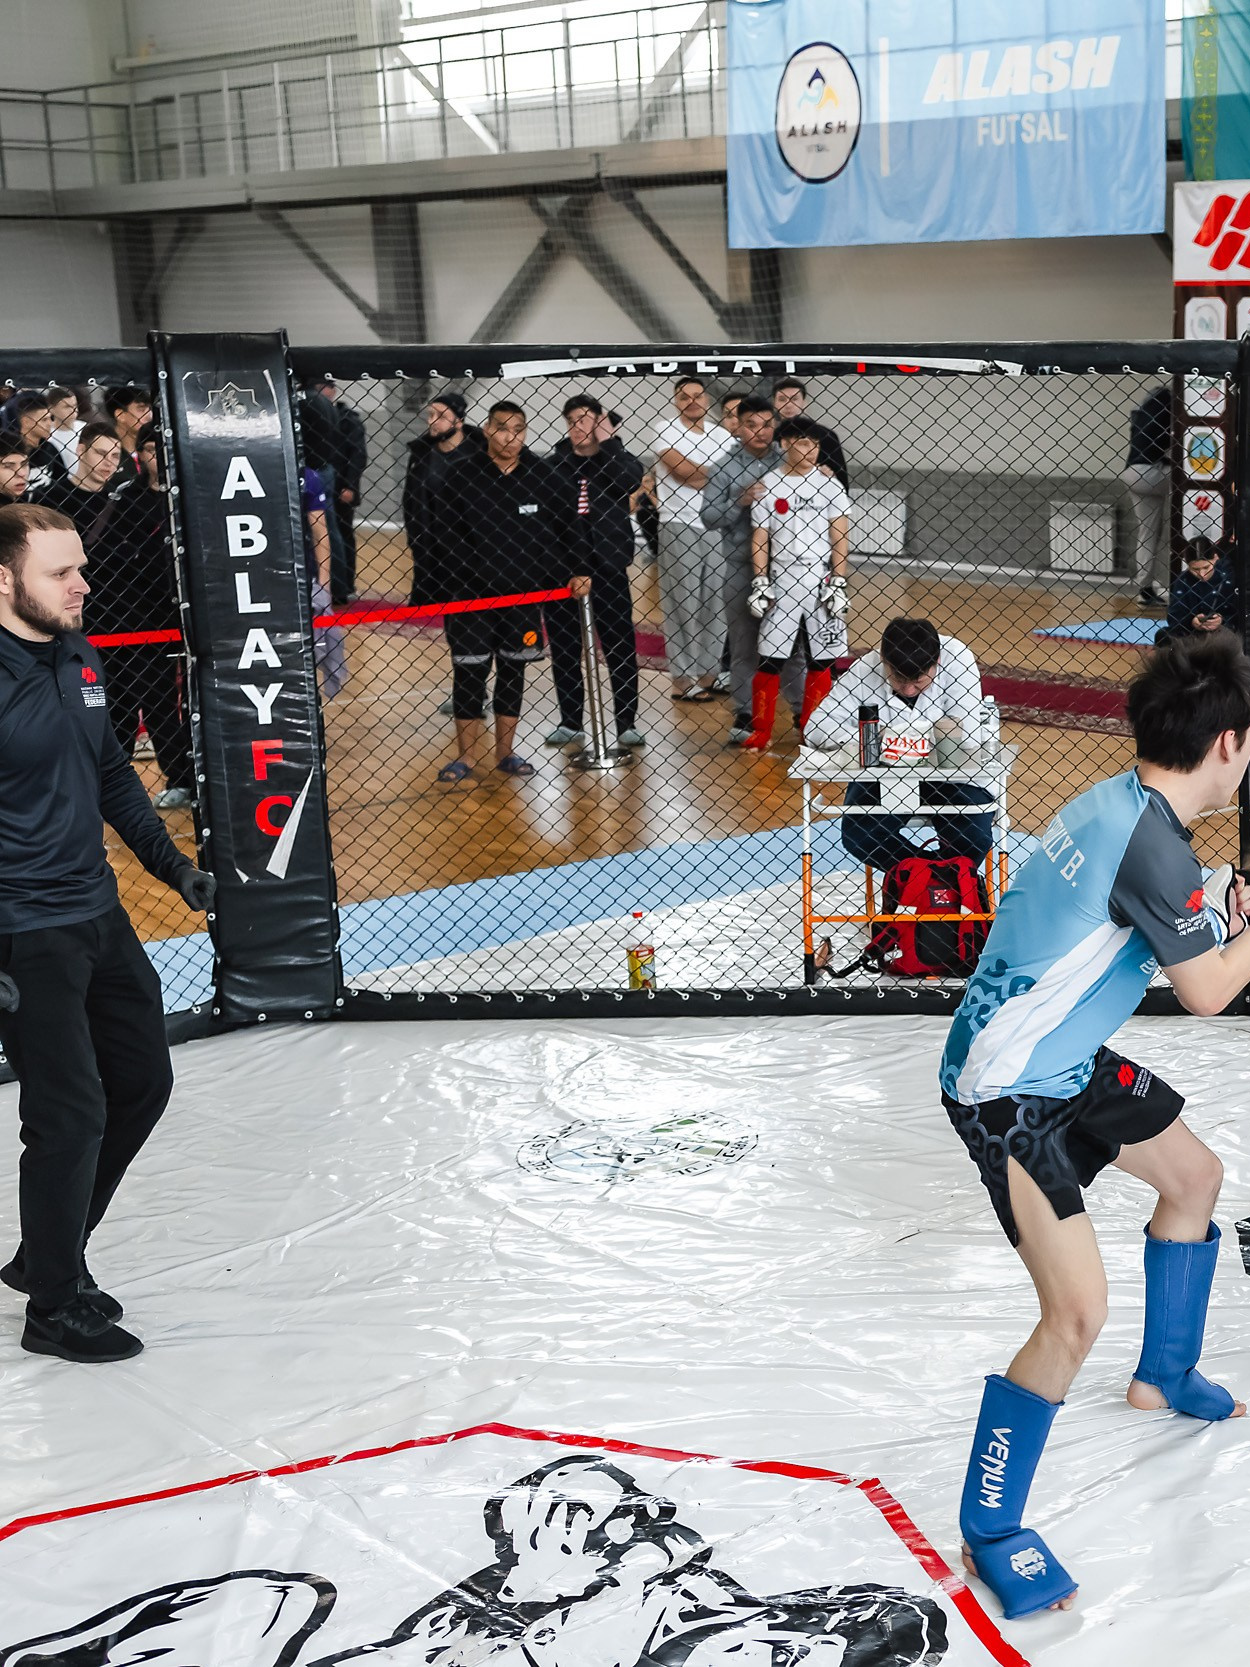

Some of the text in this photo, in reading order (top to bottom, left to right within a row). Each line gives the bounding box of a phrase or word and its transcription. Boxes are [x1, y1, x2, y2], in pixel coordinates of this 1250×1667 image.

[922, 36, 1121, 104] ALASH
[787, 120, 849, 138] ALASH
[976, 111, 1069, 147] FUTSAL
[978, 1427, 1013, 1509] VENUM
